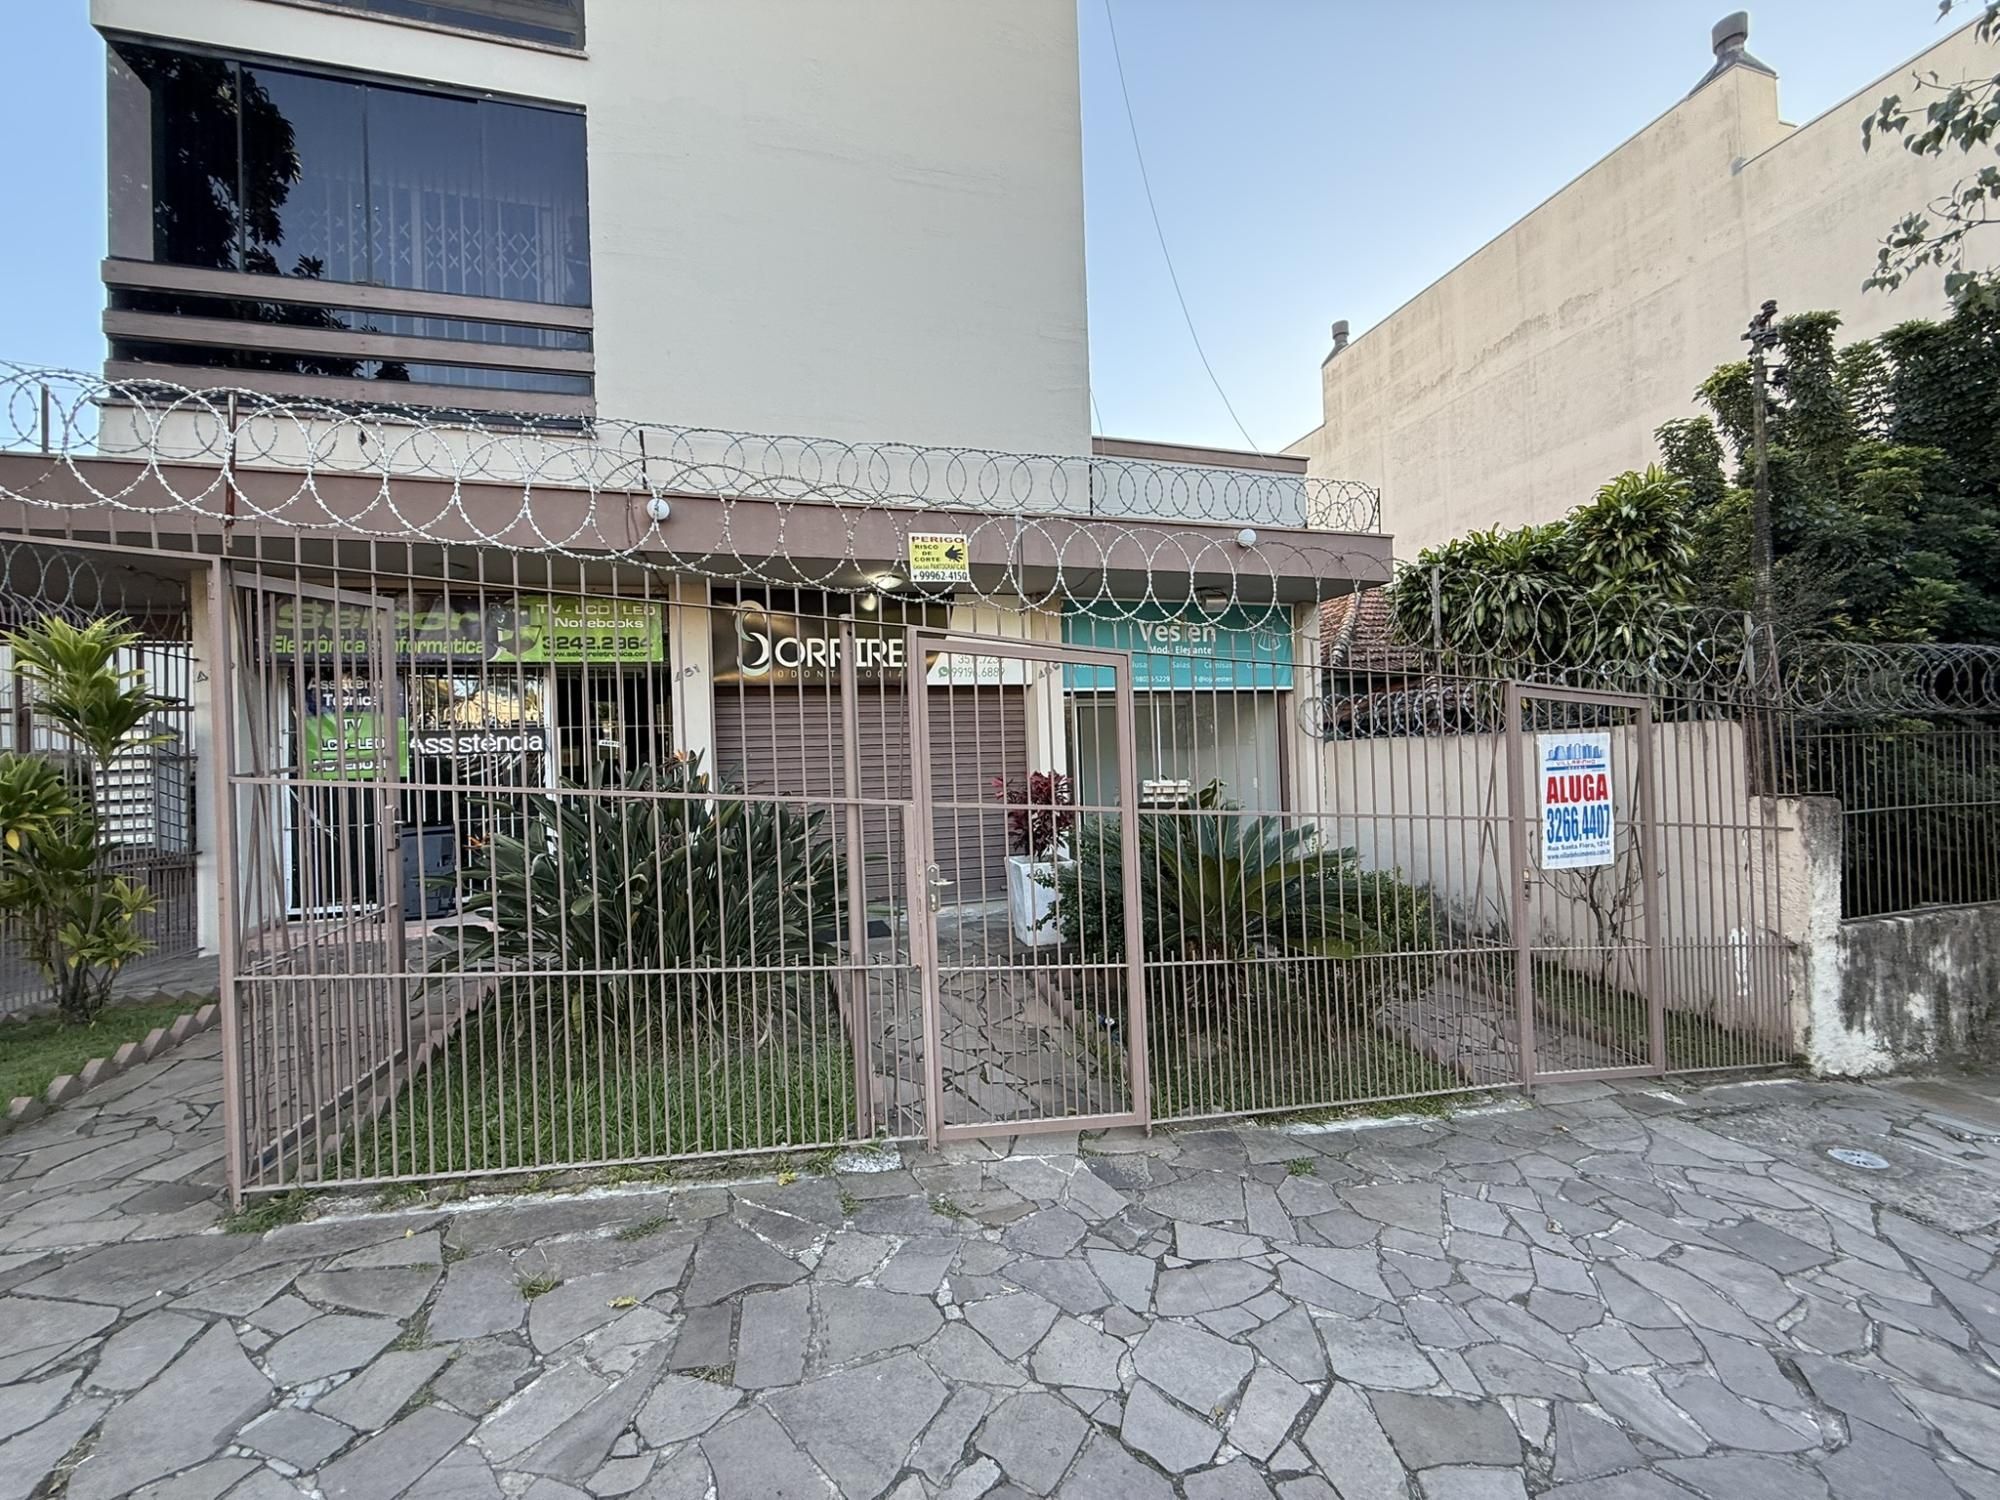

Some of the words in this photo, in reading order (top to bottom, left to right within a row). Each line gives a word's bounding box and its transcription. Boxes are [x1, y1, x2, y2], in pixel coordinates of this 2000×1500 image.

[919, 571, 968, 580] 99962-4150
[536, 604, 563, 614] TV
[575, 604, 610, 614] LCD
[622, 606, 656, 616] LED
[409, 731, 543, 754] Assstência
[1546, 773, 1609, 804] ALUGA
[1546, 804, 1610, 844] 3266.4407
